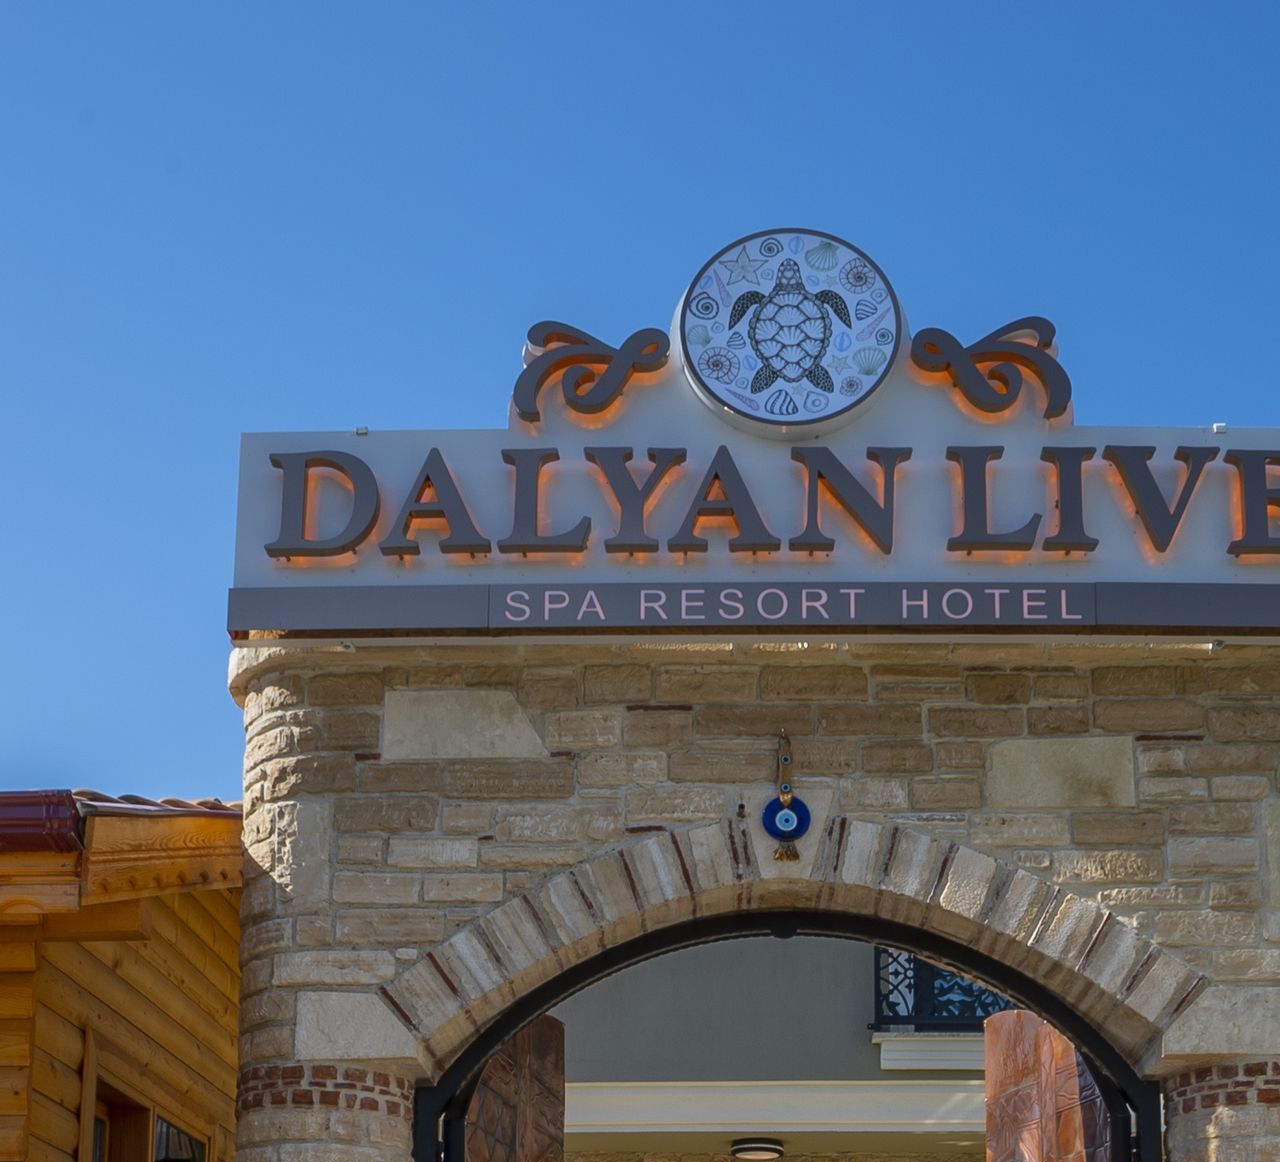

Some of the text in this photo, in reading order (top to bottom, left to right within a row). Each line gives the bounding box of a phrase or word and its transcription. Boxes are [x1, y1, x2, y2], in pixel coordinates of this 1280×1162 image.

[264, 445, 913, 556] DALYAN
[504, 588, 1083, 622] SPA RESORT HOTEL
